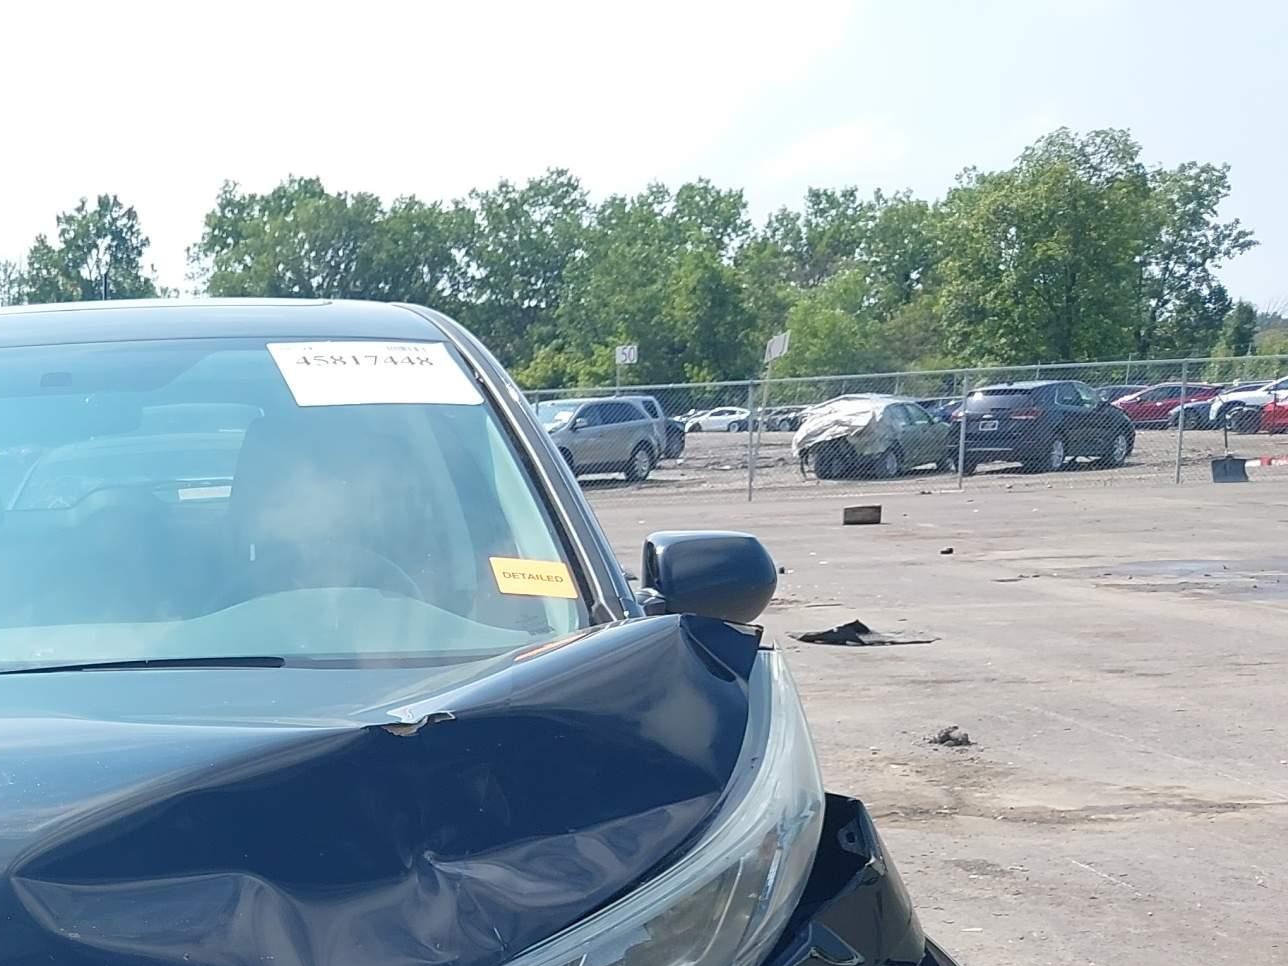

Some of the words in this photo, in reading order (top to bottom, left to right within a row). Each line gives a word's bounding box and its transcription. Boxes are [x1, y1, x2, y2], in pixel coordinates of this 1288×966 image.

[295, 354, 434, 367] 45817448
[620, 346, 635, 363] 50
[502, 571, 564, 583] DETAILED
